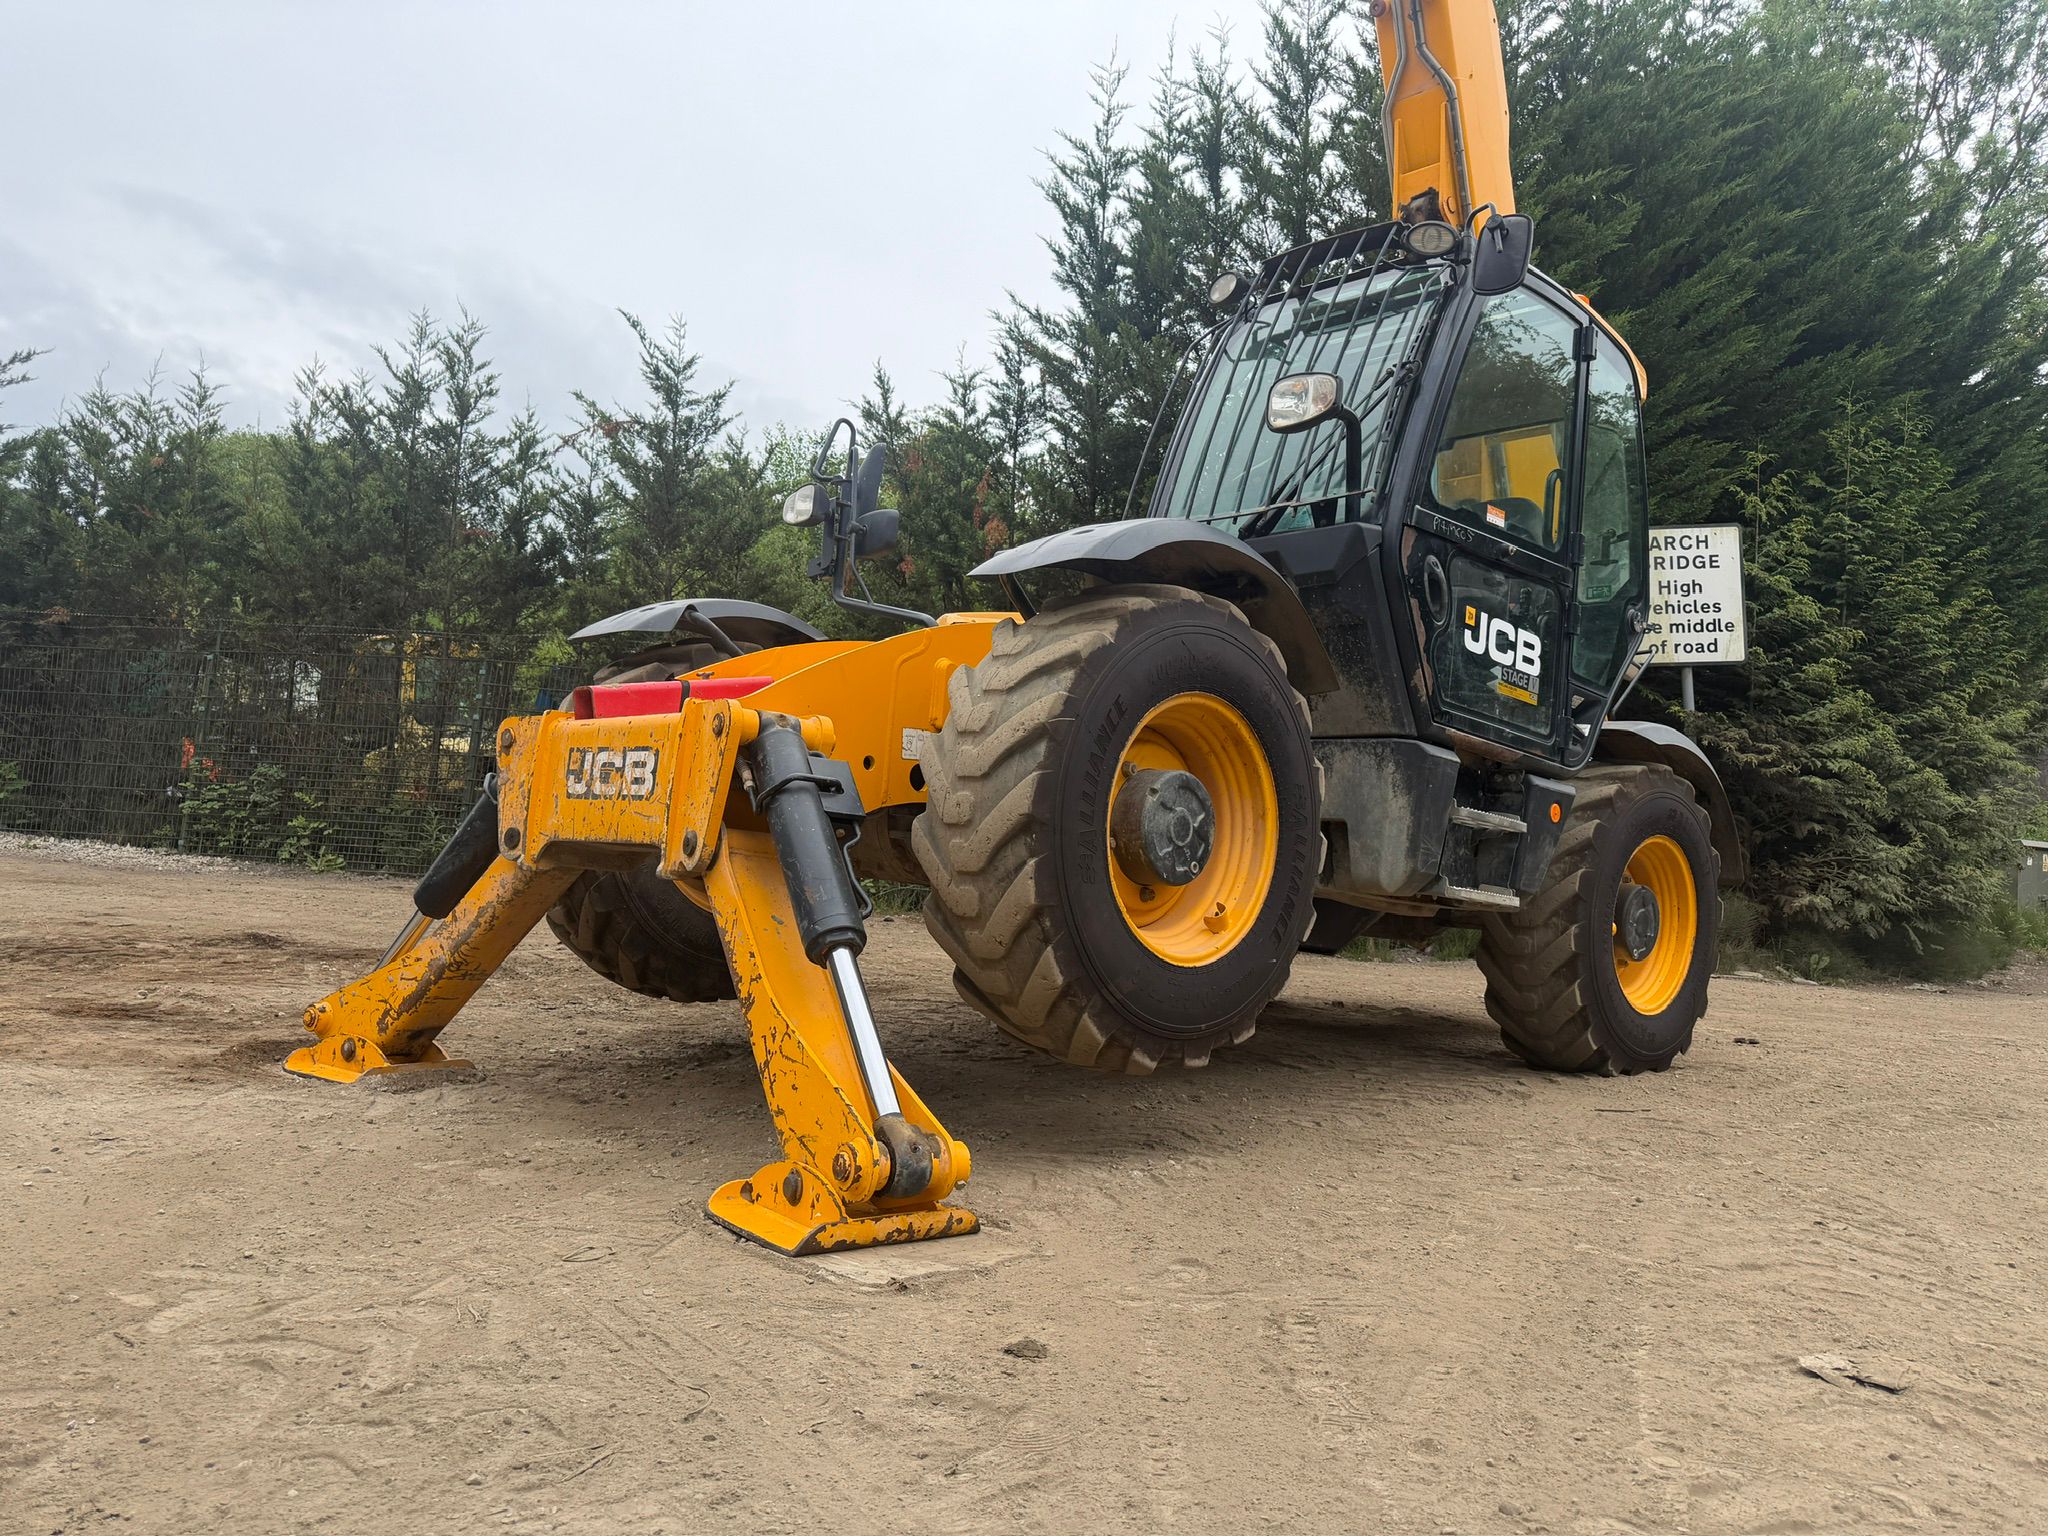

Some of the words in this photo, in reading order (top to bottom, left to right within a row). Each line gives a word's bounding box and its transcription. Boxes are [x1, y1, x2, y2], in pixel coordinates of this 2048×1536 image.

[1649, 534, 1709, 551] ARCH
[1649, 554, 1721, 570] RIDGE
[1658, 579, 1703, 597] High
[1650, 599, 1722, 615] ehicles
[1669, 618, 1735, 634] middle
[1464, 611, 1541, 677] JCB
[1674, 637, 1719, 654] road
[1502, 667, 1528, 688] STAGE
[567, 750, 656, 796] JCB
[1079, 694, 1128, 855] ALLIANCE
